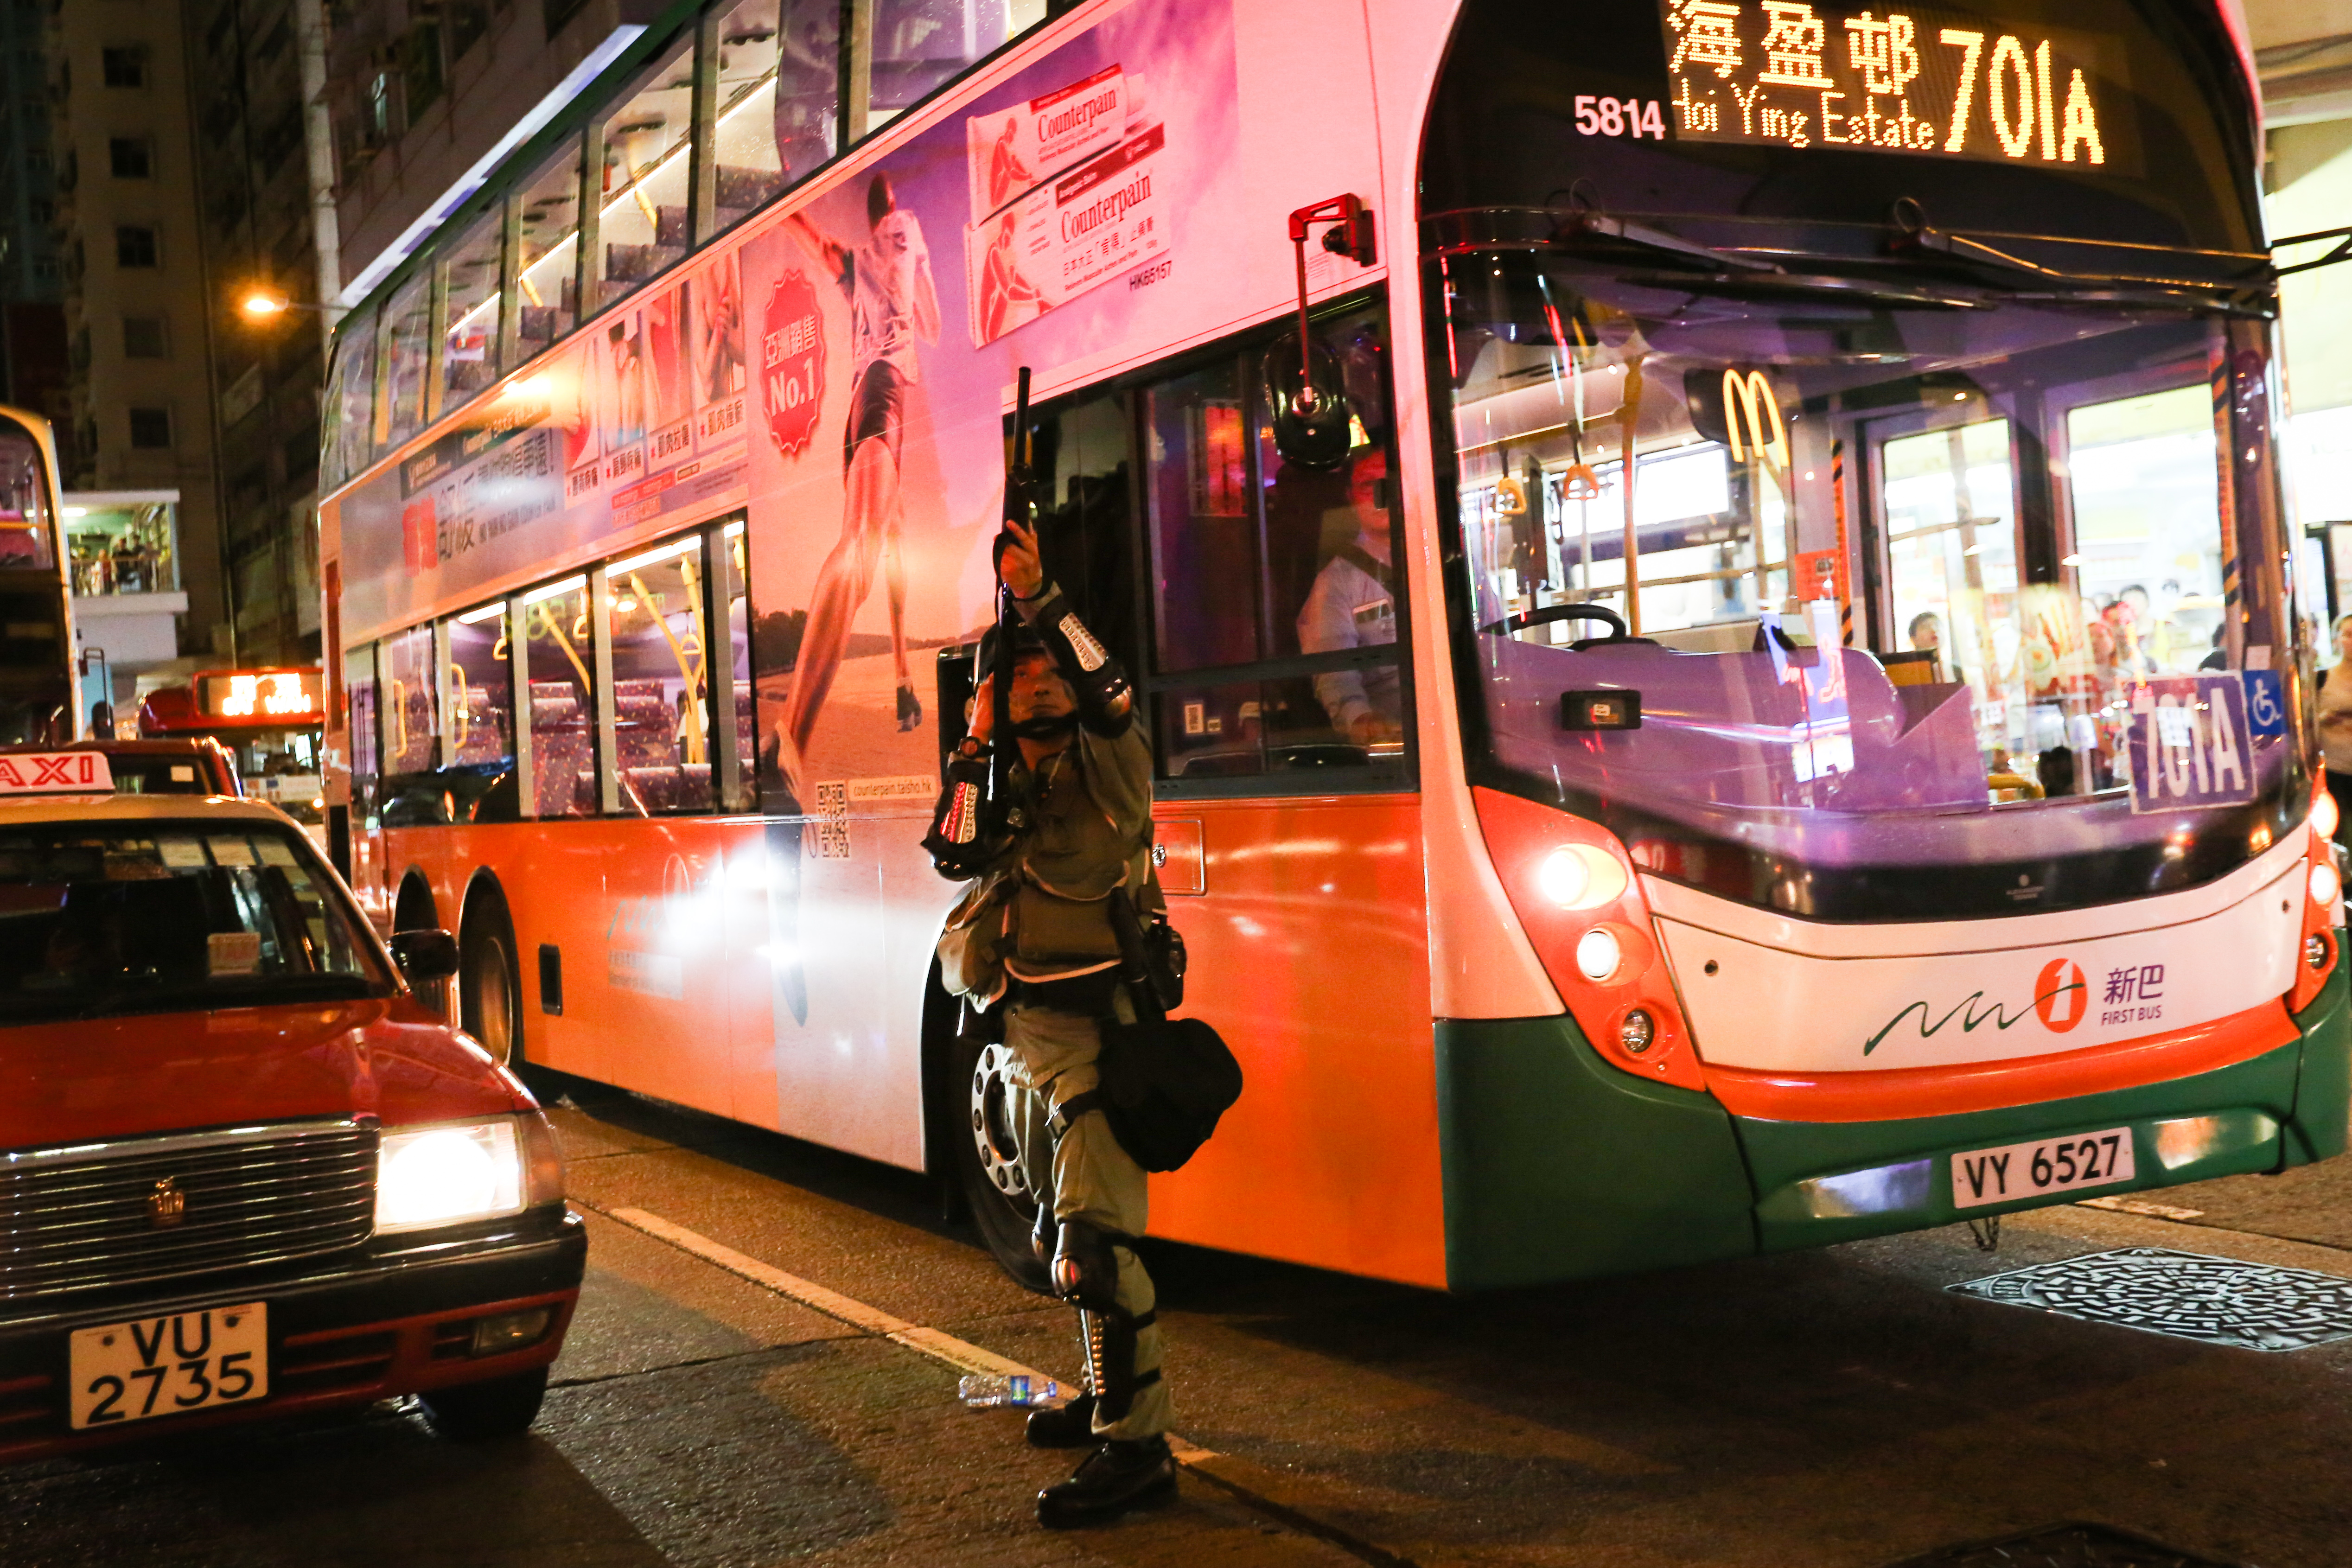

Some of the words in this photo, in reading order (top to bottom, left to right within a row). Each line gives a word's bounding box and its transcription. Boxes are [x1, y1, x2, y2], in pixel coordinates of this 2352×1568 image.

[1666, 0, 1919, 95] 海盈邨
[1038, 86, 1117, 142] Counterpain
[1575, 95, 1666, 140] 5814
[1730, 82, 1810, 148] Ying
[1820, 90, 1935, 150] Estate
[1939, 28, 2105, 165] 701A
[1062, 170, 1152, 243] Counterpain
[770, 356, 815, 417] No.1
[2101, 1008, 2135, 1026] FIRST
[2138, 1005, 2162, 1021] BUS
[2103, 964, 2164, 1005] 新巴
[1964, 1152, 2011, 1199] VY
[2031, 1135, 2121, 1188] 6527
[130, 1312, 211, 1367] VU
[87, 1351, 254, 1425] 2735
